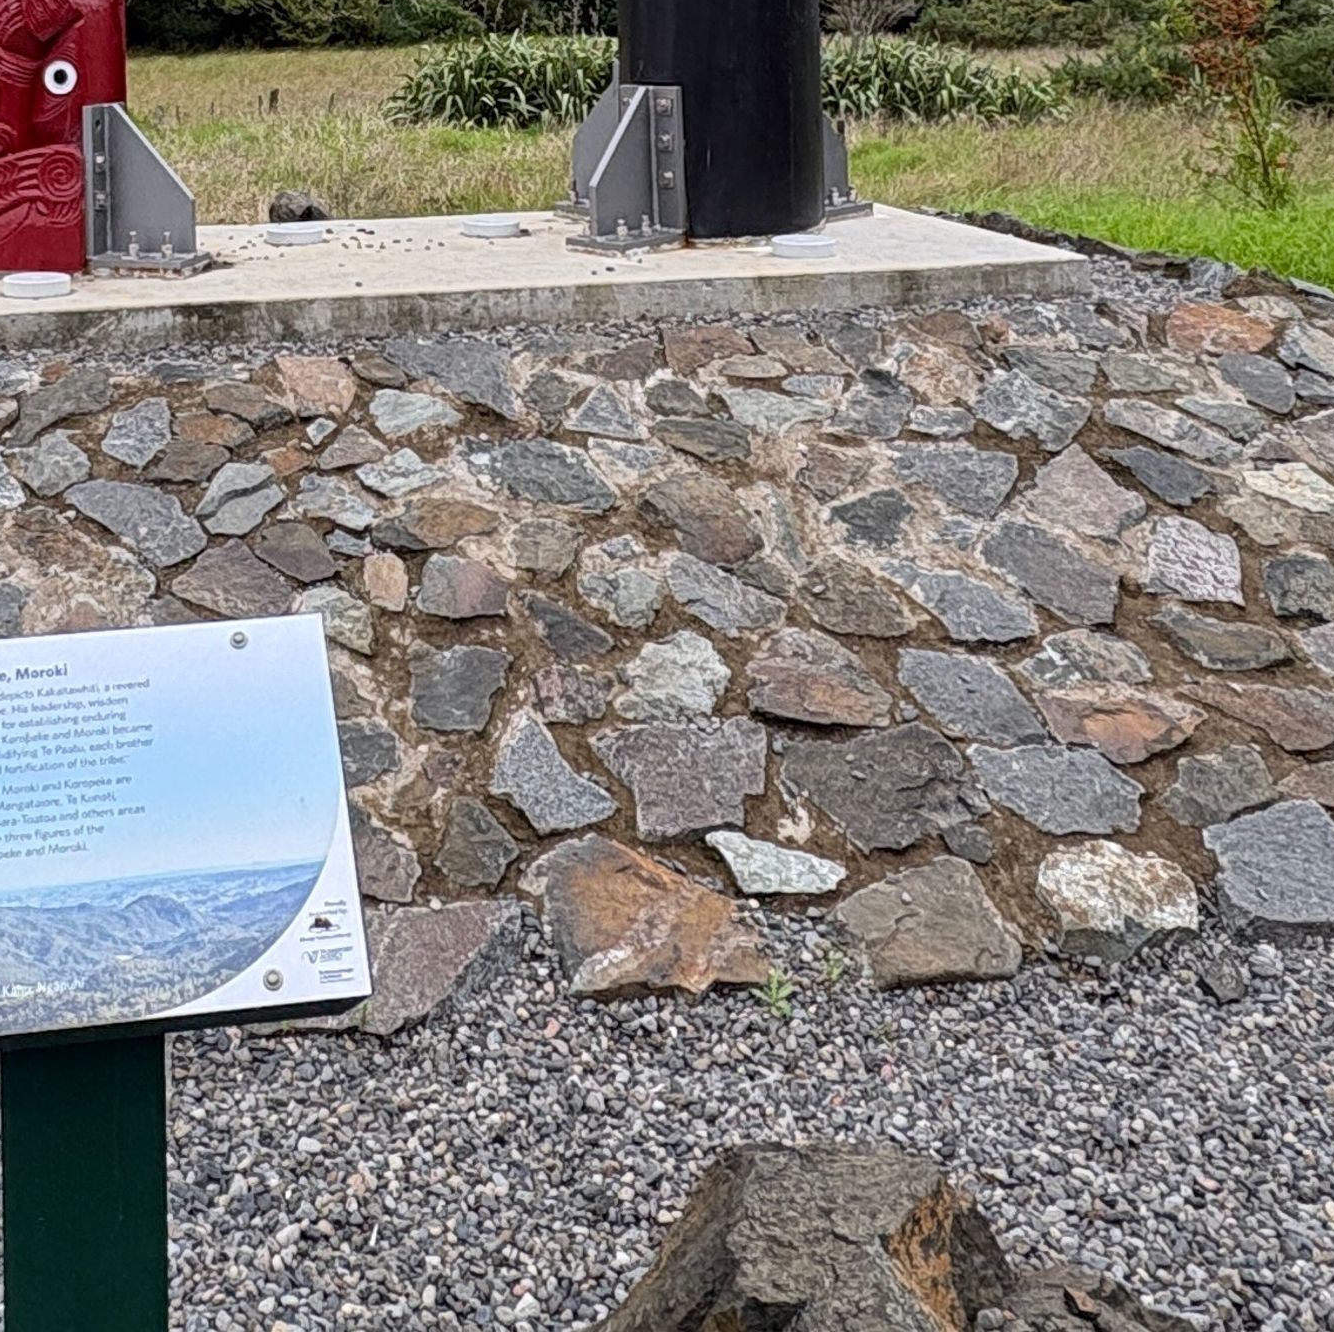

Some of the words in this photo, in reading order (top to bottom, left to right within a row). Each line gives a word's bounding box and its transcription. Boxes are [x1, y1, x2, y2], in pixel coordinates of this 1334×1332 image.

[16, 664, 68, 680] Moroki
[12, 705, 28, 714] His
[2, 720, 15, 730] for
[53, 729, 71, 740] and
[42, 746, 52, 755] Te
[89, 740, 113, 751] each
[67, 758, 77, 768] of
[80, 757, 96, 767] the
[42, 780, 61, 791] and
[116, 776, 132, 784] are
[67, 795, 77, 805] Te
[59, 810, 79, 821] and
[74, 825, 84, 835] of
[87, 824, 104, 834] the
[25, 845, 45, 857] and
